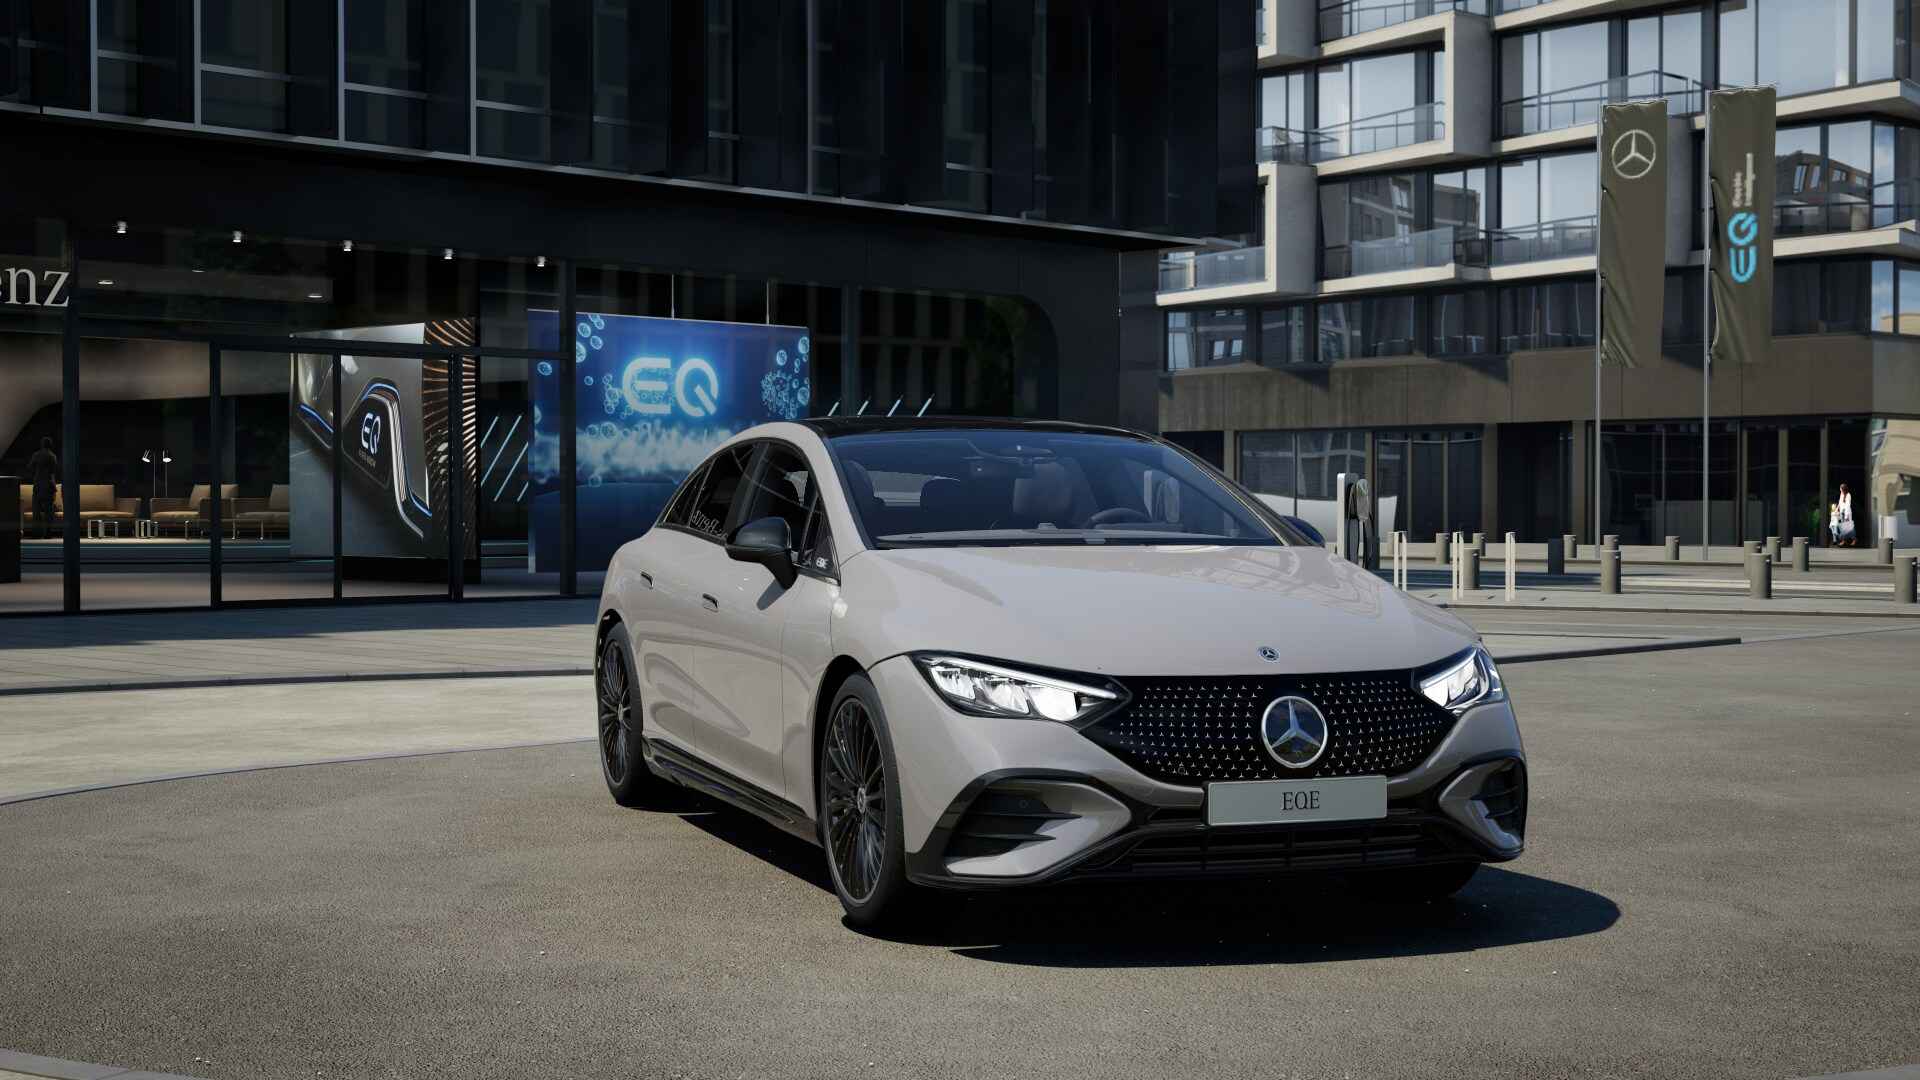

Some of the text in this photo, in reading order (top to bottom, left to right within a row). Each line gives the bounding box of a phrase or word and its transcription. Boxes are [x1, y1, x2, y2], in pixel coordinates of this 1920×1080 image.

[1728, 212, 1758, 283] EQ
[0, 267, 70, 308] nz
[622, 357, 719, 417] EQ
[361, 412, 381, 455] EQ
[1282, 791, 1320, 811] EQE
